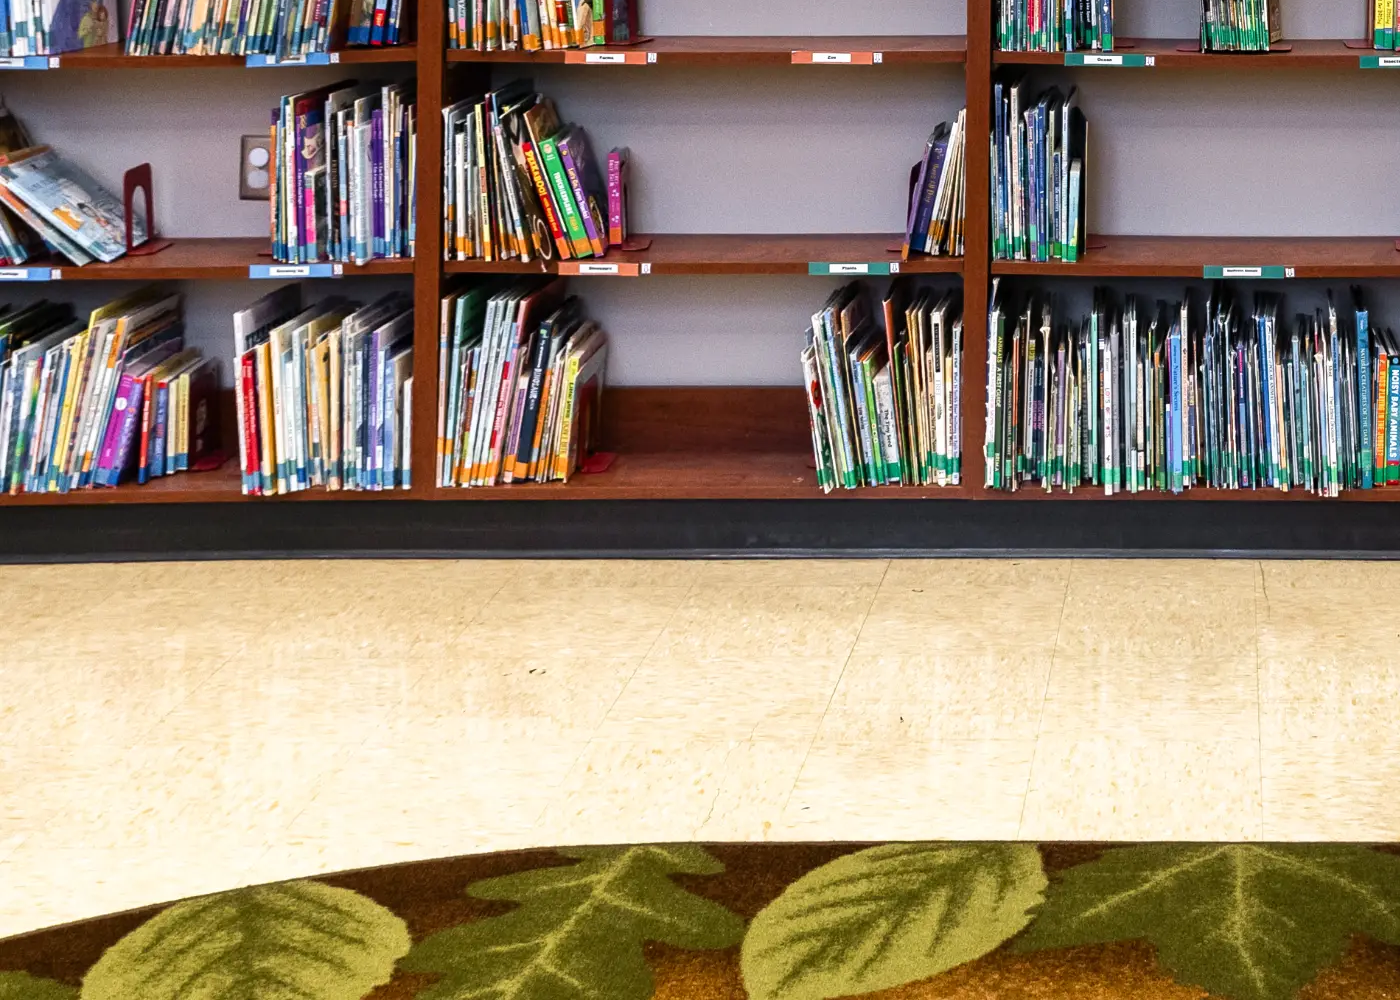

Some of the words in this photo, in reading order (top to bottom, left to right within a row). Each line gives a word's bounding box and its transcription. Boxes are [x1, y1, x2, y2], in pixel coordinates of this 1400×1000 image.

[524, 150, 547, 196] PEEKABOO!
[1391, 369, 1400, 394] NOISY
[1361, 405, 1367, 415] OF
[1390, 396, 1399, 417] BABY
[1389, 419, 1399, 458] ANIMALS
